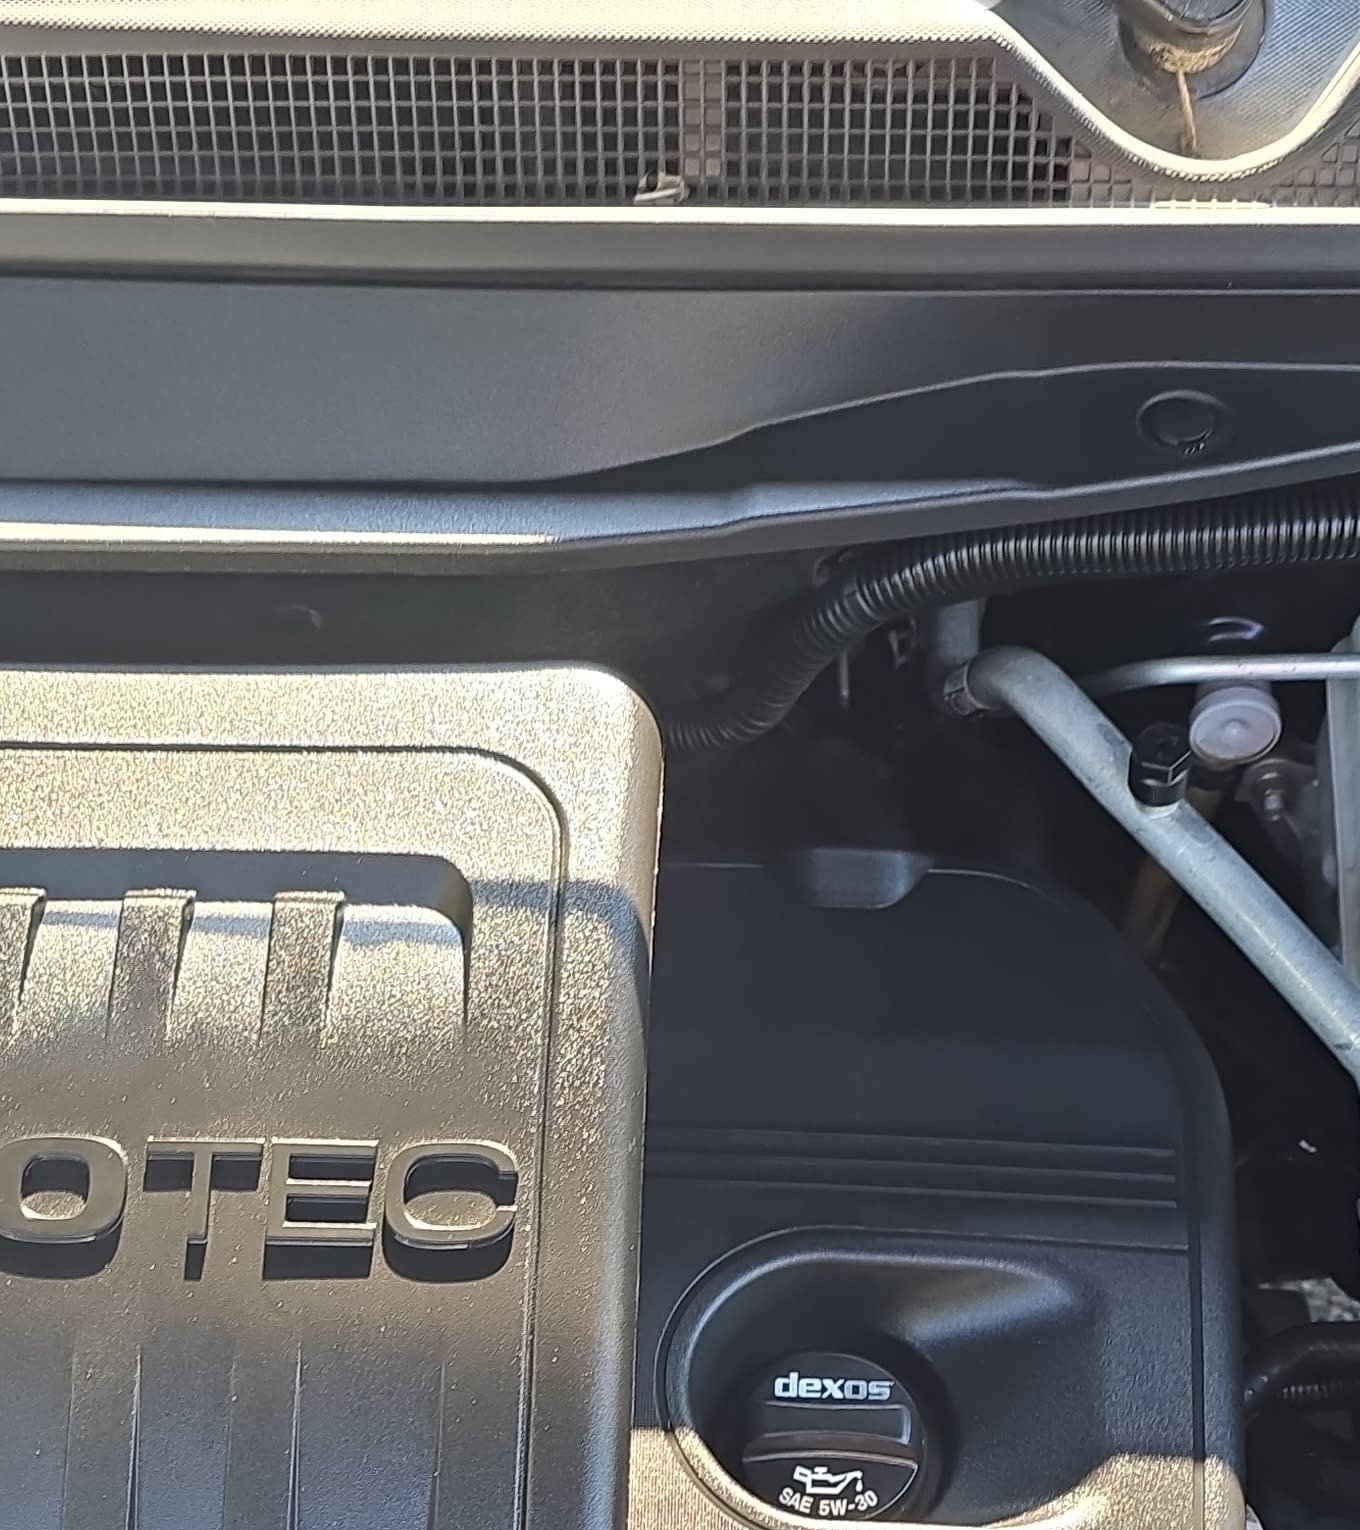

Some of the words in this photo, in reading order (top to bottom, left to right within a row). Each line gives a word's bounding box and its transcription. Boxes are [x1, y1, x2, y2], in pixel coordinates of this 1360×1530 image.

[774, 1372, 894, 1400] dexos
[779, 1487, 814, 1514] SAE
[819, 1489, 878, 1516] 5W-30
